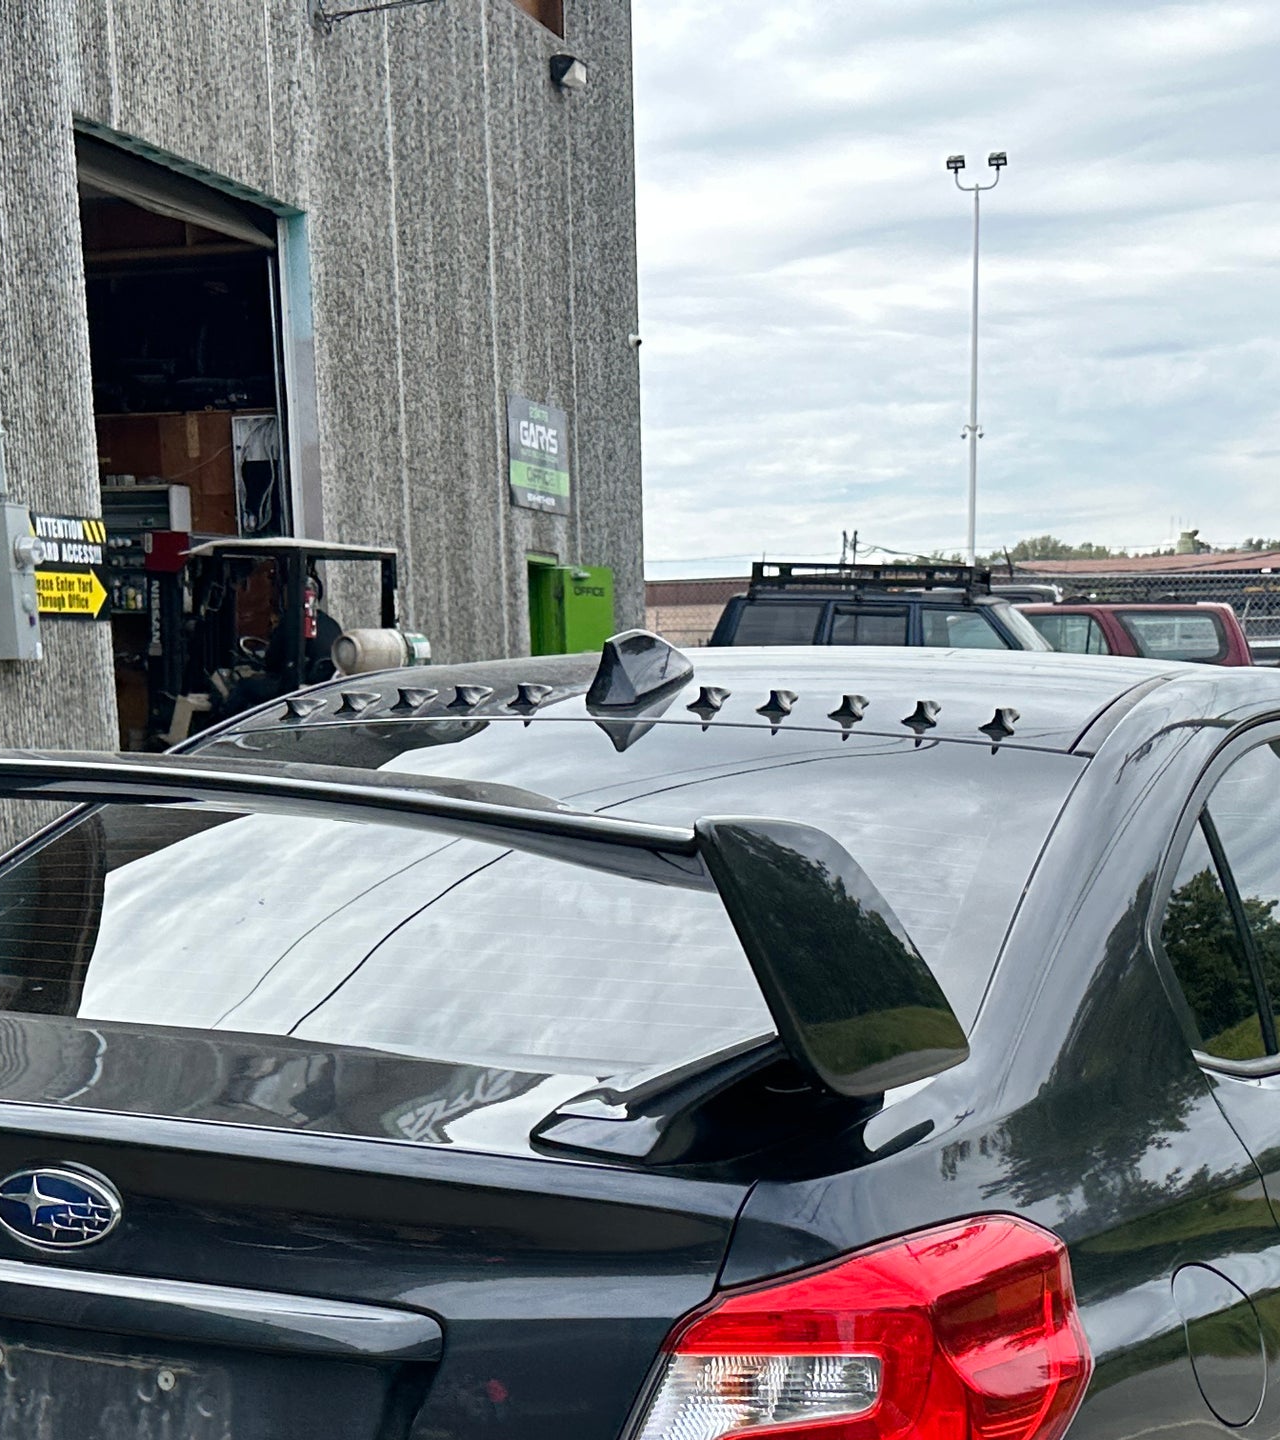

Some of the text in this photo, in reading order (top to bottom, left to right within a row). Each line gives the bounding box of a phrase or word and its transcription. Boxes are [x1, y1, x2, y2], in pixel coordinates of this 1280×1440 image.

[36, 517, 84, 540] ATTENTION
[36, 579, 54, 592] ease
[76, 577, 94, 594] Yard
